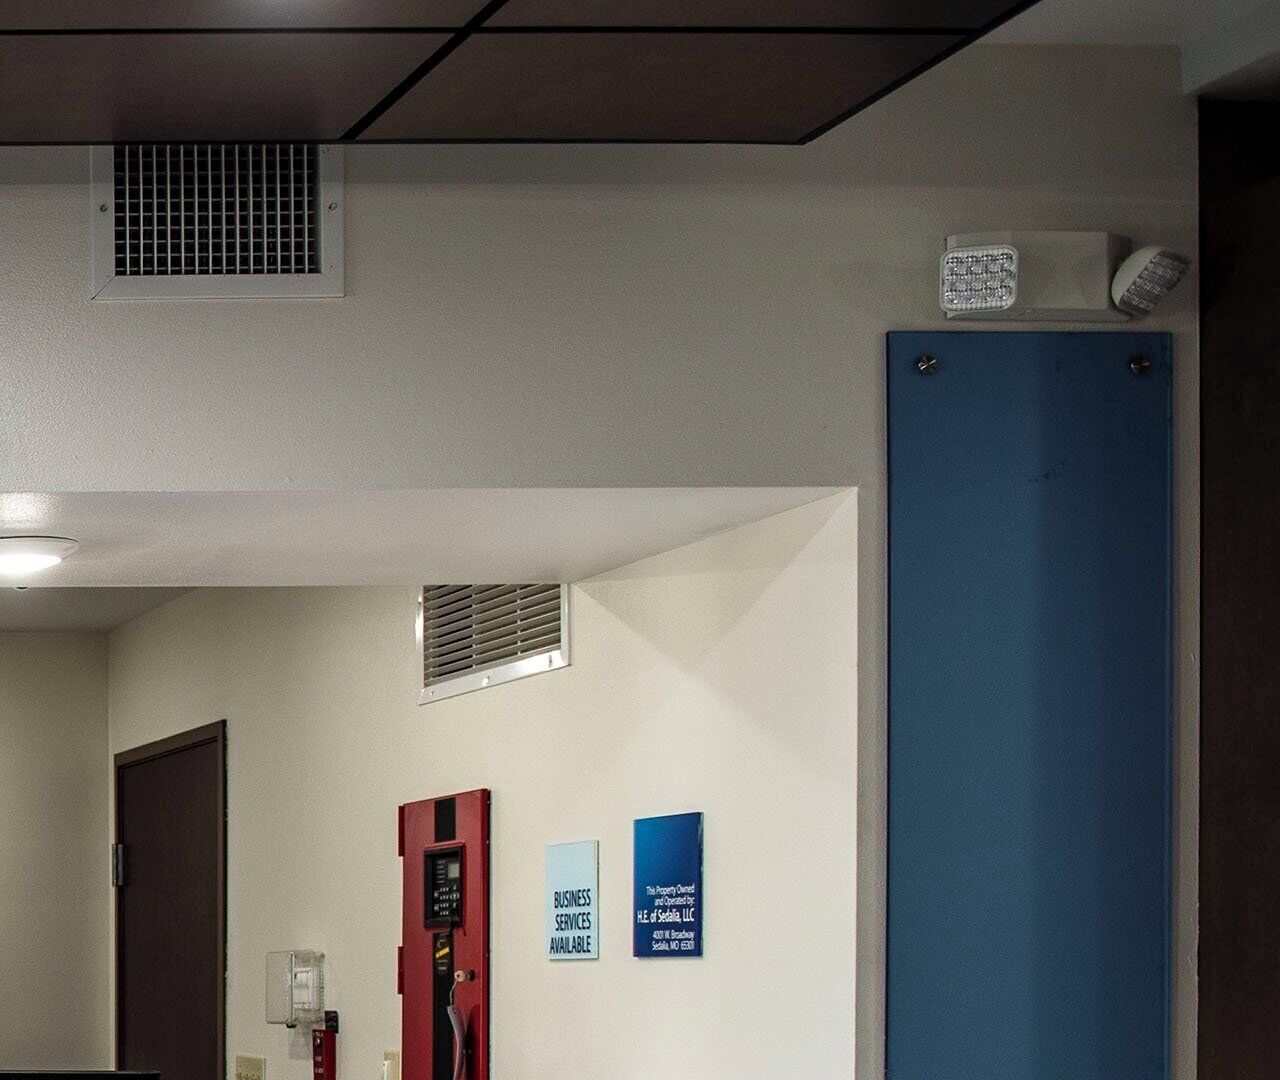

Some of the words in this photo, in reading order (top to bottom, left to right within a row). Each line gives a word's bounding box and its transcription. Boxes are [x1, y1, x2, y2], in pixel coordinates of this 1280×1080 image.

[646, 886, 656, 895] This
[656, 885, 676, 896] Property
[677, 883, 695, 894] Owned
[554, 888, 591, 909] BUSINESS
[654, 897, 663, 906] and
[664, 895, 686, 907] Operated
[555, 911, 591, 931] SERVICES
[650, 908, 657, 923] of
[658, 908, 681, 924] Sedalia,
[682, 907, 695, 922] LLC
[671, 929, 695, 941] Broadway
[549, 935, 591, 954] AVAILABLE
